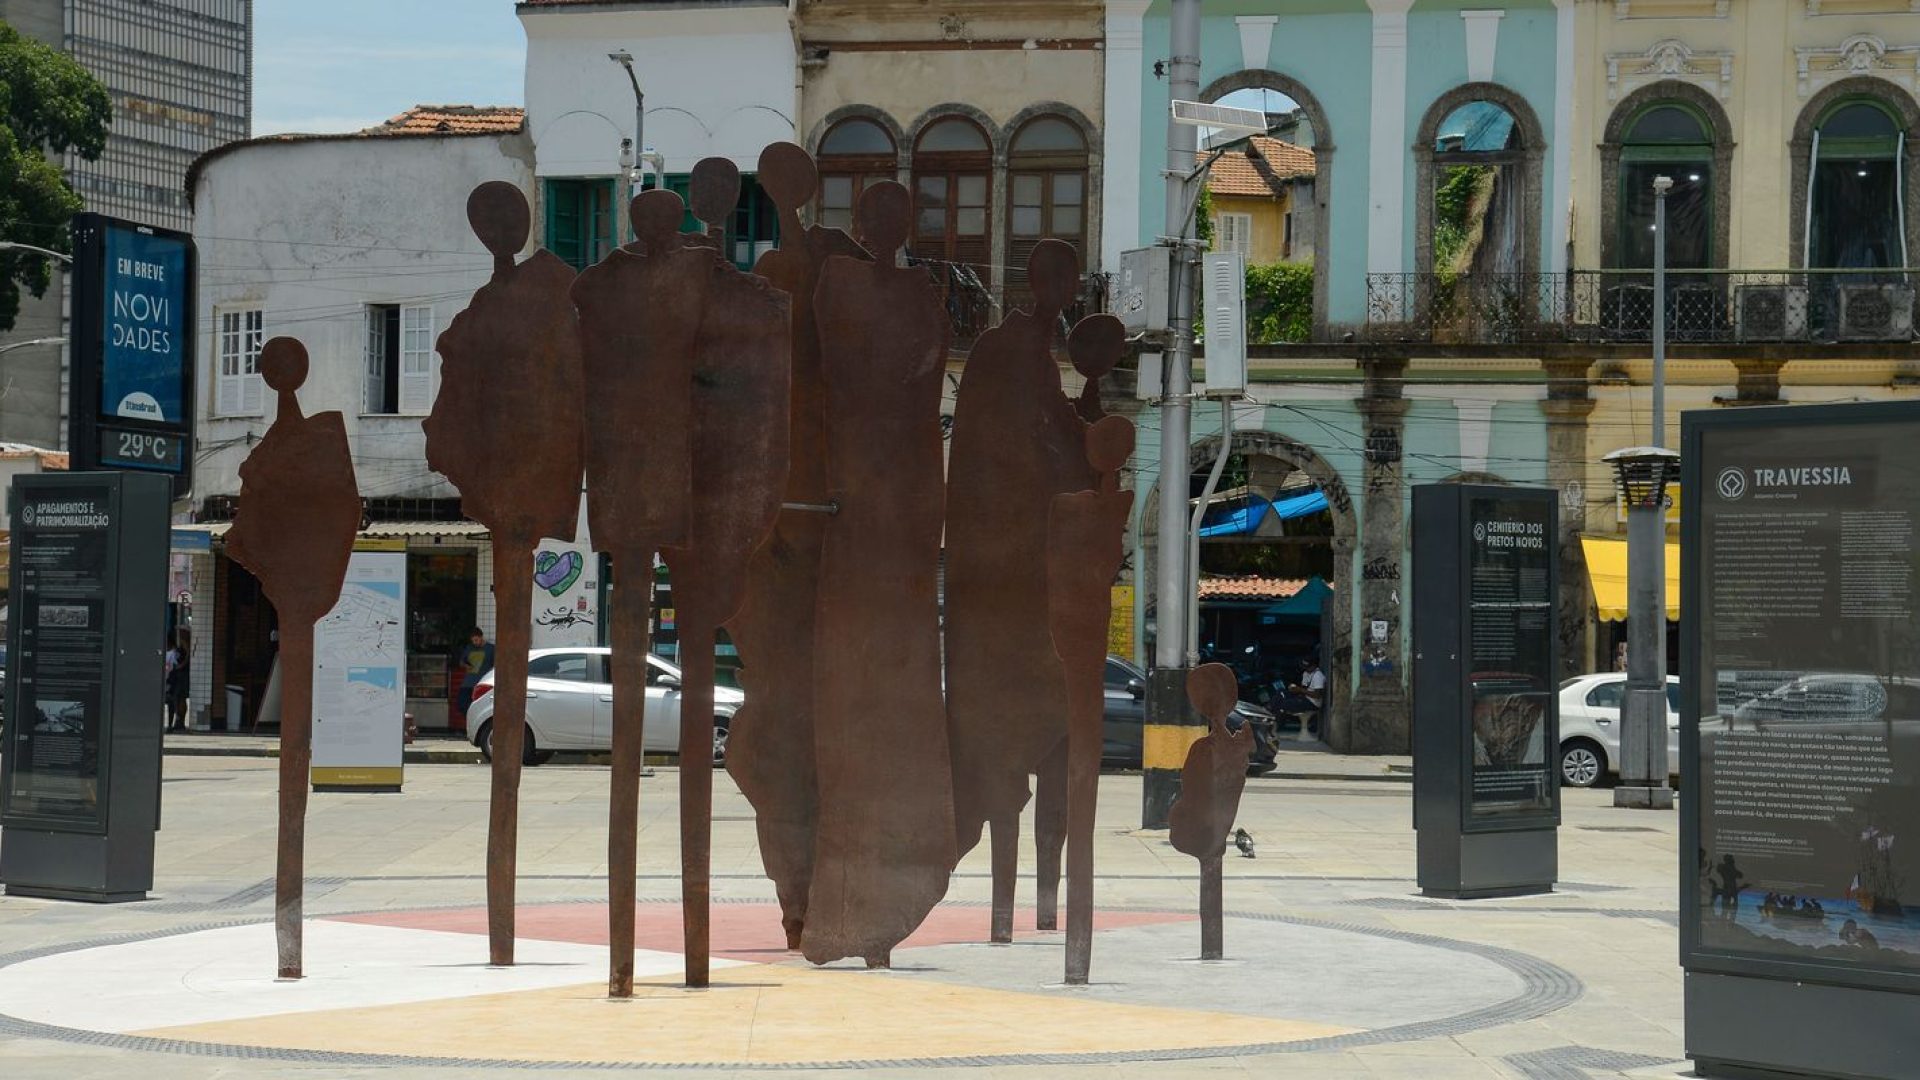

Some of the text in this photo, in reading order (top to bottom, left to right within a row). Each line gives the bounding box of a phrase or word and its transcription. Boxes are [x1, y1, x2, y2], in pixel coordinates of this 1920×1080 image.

[117, 258, 164, 282] EM BREVE
[114, 291, 168, 326] NOVI
[1754, 467, 1852, 486] TRAVESSIA
[36, 502, 95, 514] APAGAMENTOS E
[36, 513, 109, 528] PATRIMONIALIZAÇÃO
[1527, 523, 1543, 534] DOS
[1488, 536, 1542, 548] PRETOS NOVOS
